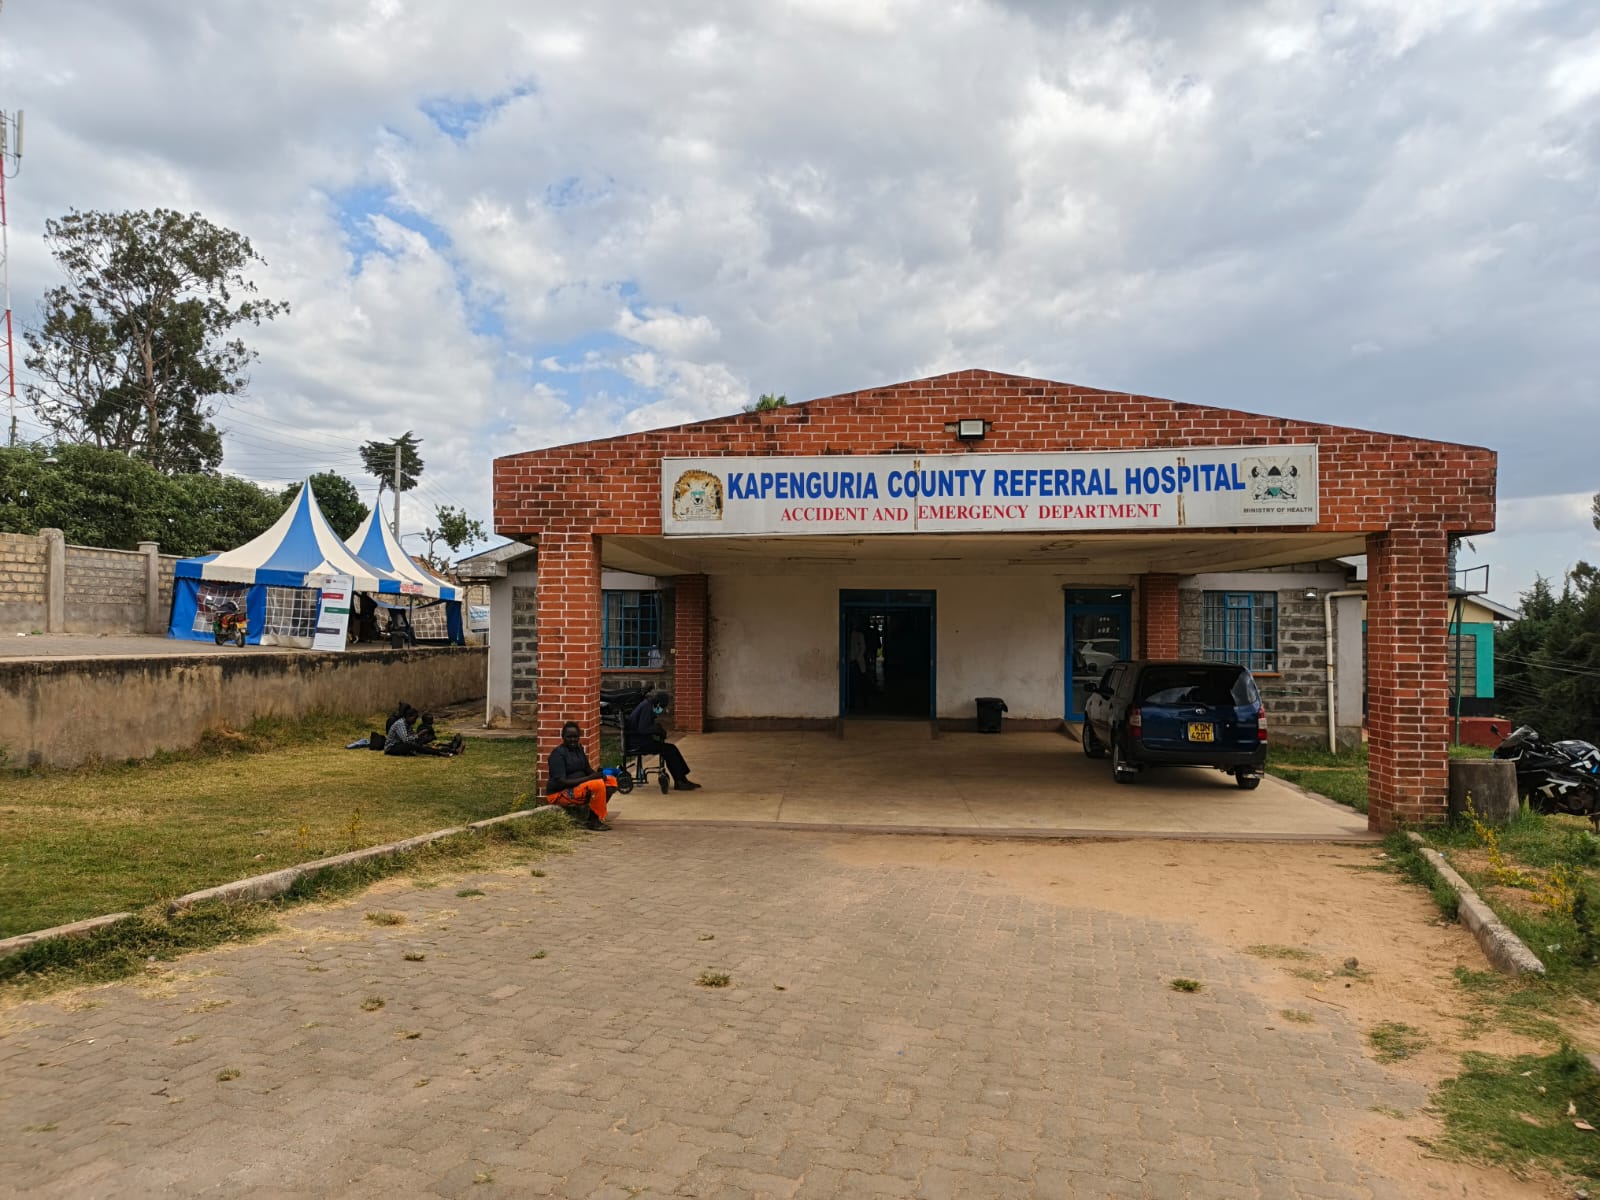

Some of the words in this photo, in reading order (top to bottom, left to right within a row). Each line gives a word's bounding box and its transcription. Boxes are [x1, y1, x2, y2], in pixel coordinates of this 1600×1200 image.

[728, 471, 878, 500] KAPENGURIA
[887, 469, 986, 498] COUNTY
[993, 468, 1118, 497] REFERRAL
[1125, 463, 1246, 495] HOSPITAL
[781, 507, 869, 522] ACCIDENT
[872, 506, 909, 522] AND
[918, 504, 1028, 520] EMERGENCY
[1039, 503, 1162, 519] DEPARTMENT
